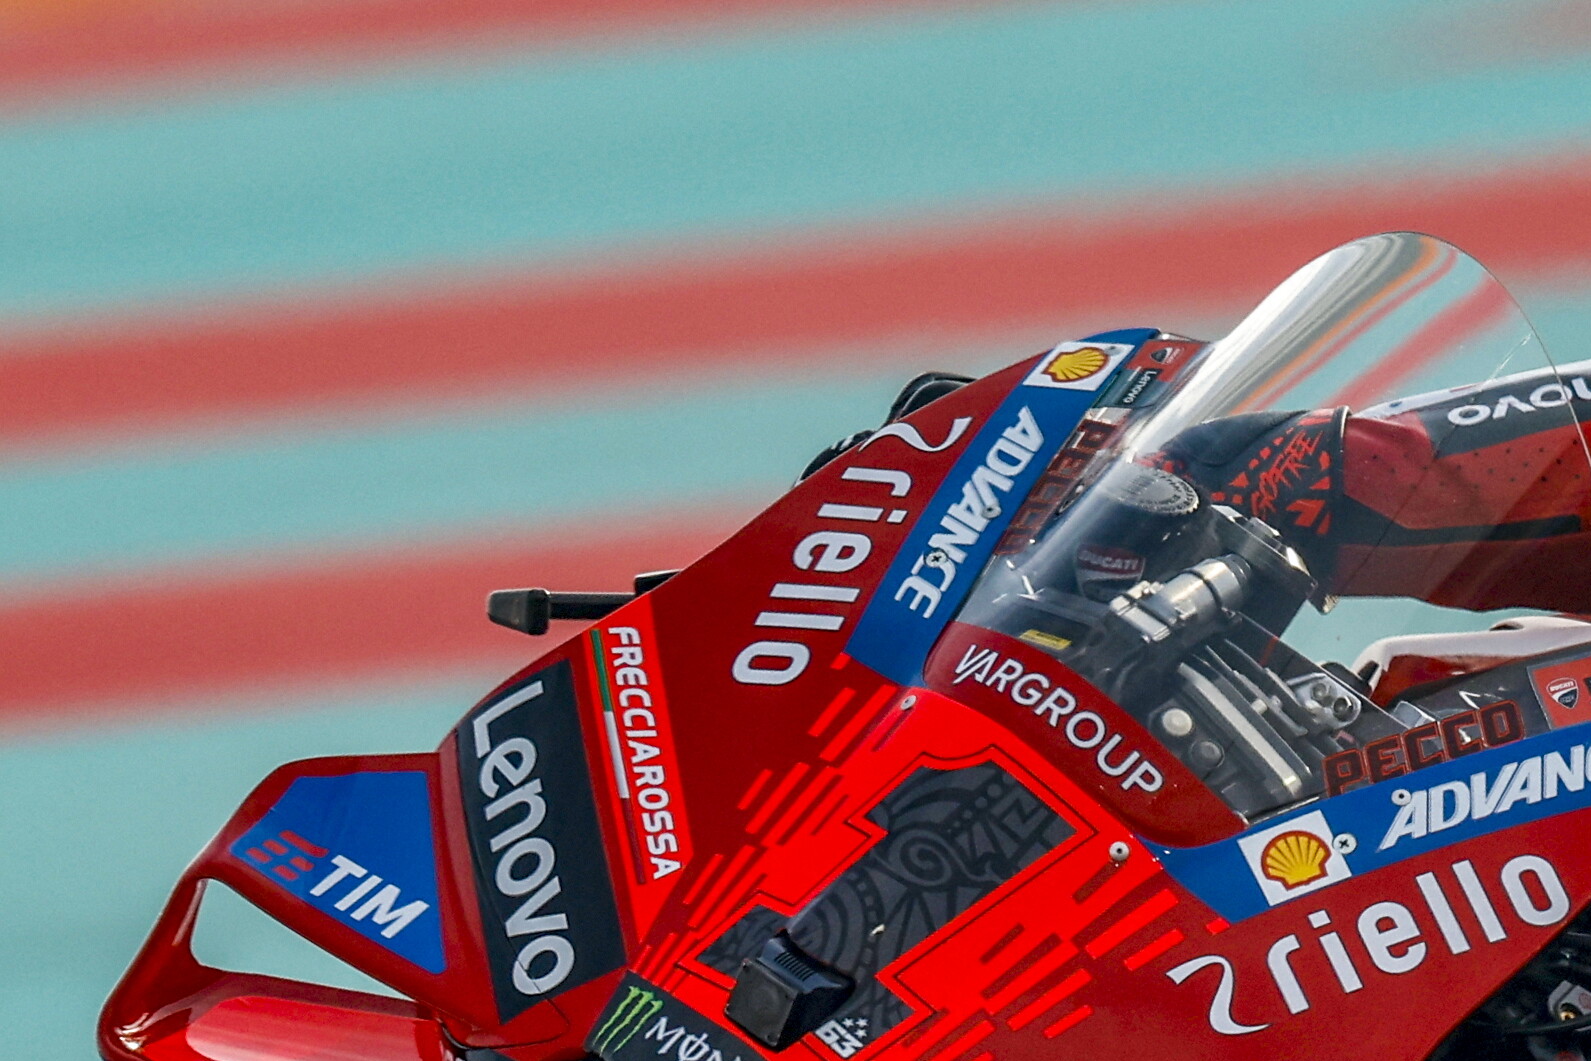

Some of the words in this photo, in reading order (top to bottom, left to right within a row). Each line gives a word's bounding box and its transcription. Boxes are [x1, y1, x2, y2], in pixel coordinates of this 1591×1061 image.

[732, 465, 915, 686] riello
[893, 405, 1046, 620] ADVANCE
[607, 625, 682, 881] FRECCIAROSSA
[953, 644, 1164, 795] VARGROUP
[1321, 699, 1527, 799] PECCO
[309, 853, 430, 939] TIM
[472, 680, 576, 996] Lenovo
[1266, 854, 1571, 1016] riello
[813, 1020, 866, 1061] 63
